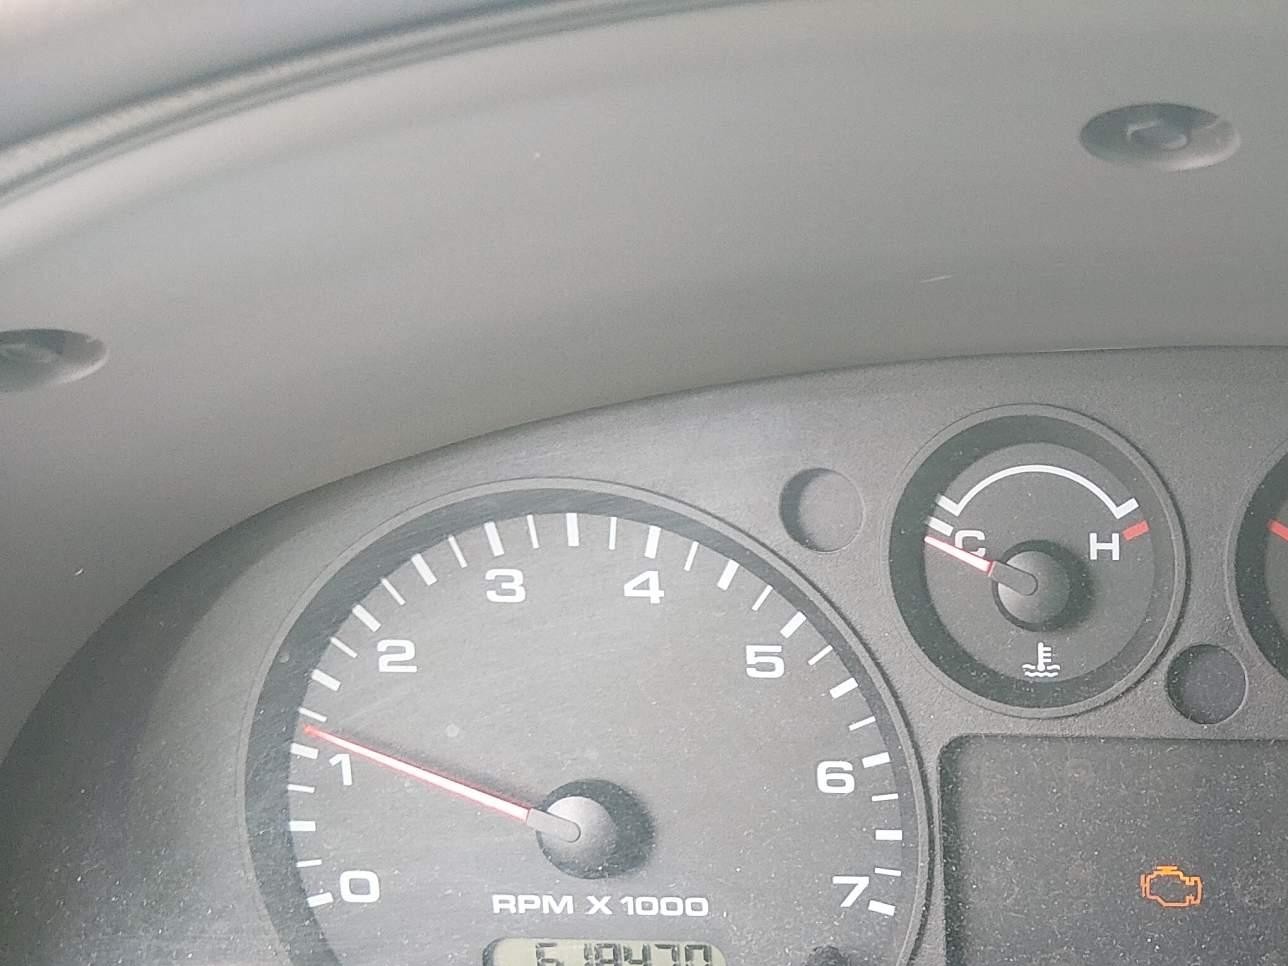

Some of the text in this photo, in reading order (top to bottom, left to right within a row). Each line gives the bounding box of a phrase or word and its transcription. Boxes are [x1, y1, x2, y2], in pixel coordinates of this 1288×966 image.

[954, 530, 986, 559] C
[1090, 533, 1119, 561] H
[485, 569, 526, 602] 3
[624, 571, 664, 603] 4
[377, 640, 417, 673] 2
[746, 645, 784, 679] 5
[329, 754, 352, 785] 1
[817, 761, 855, 794] 6
[340, 870, 380, 903] 0
[832, 876, 871, 907] 7
[492, 895, 709, 916] RPM X 1000
